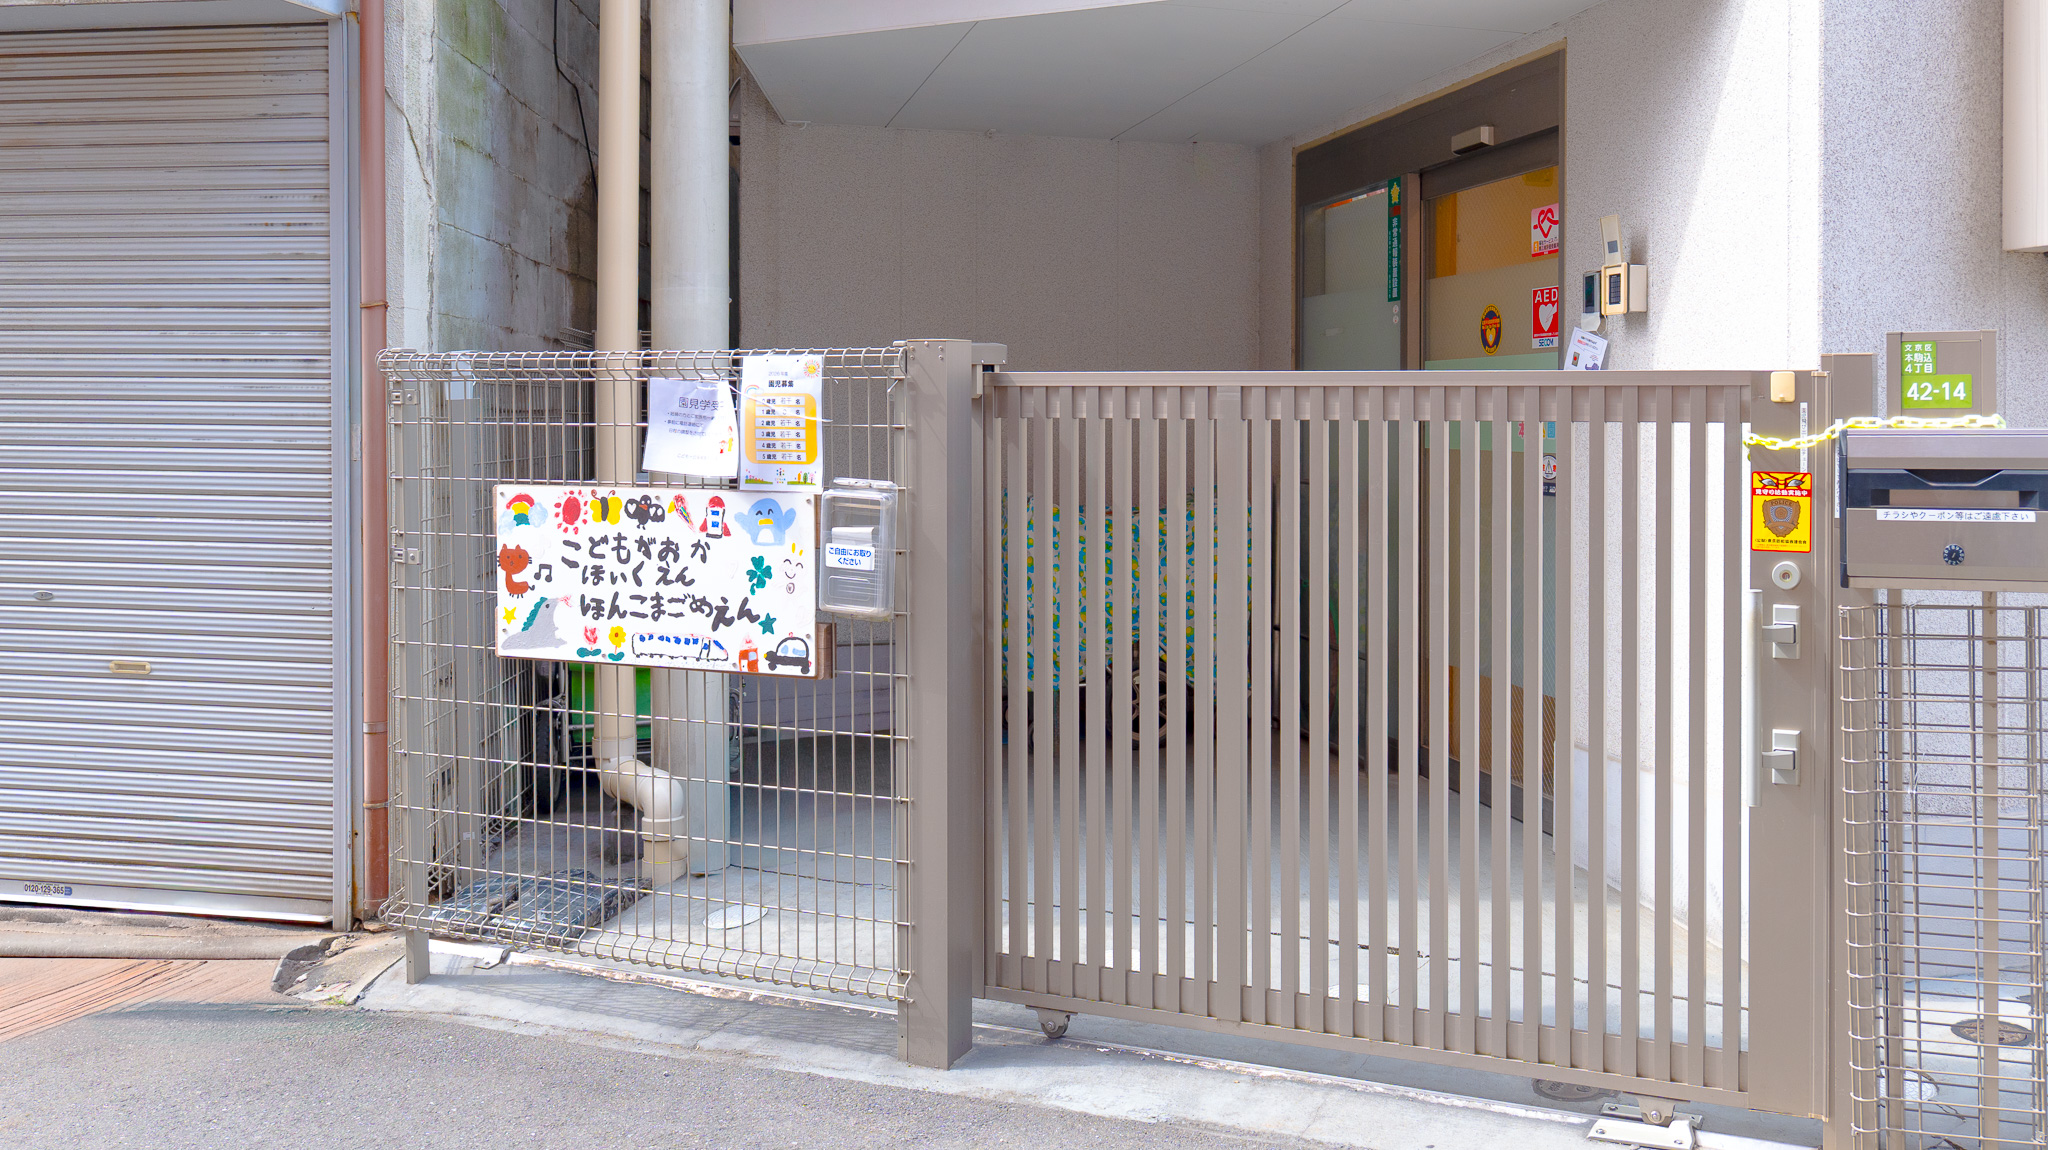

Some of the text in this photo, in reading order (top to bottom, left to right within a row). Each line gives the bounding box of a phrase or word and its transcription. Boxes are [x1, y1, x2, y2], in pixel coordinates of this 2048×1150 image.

[1535, 288, 1558, 303] AED
[1538, 337, 1554, 347] SECOM
[1904, 343, 1933, 352] 文京区
[1904, 352, 1933, 363] 本駒込
[1904, 363, 1933, 374] 4丁目
[768, 379, 794, 388] 園児募集
[1906, 381, 1967, 401] 42-14
[1883, 510, 2029, 521] チラシやクーポン等はご遠慮下さい
[561, 531, 711, 569] こどもがおか
[828, 546, 872, 558] ご自由にお取り
[837, 557, 861, 566] ください
[580, 561, 696, 587] ほいくえん
[579, 590, 761, 632] ほんこまごめえん
